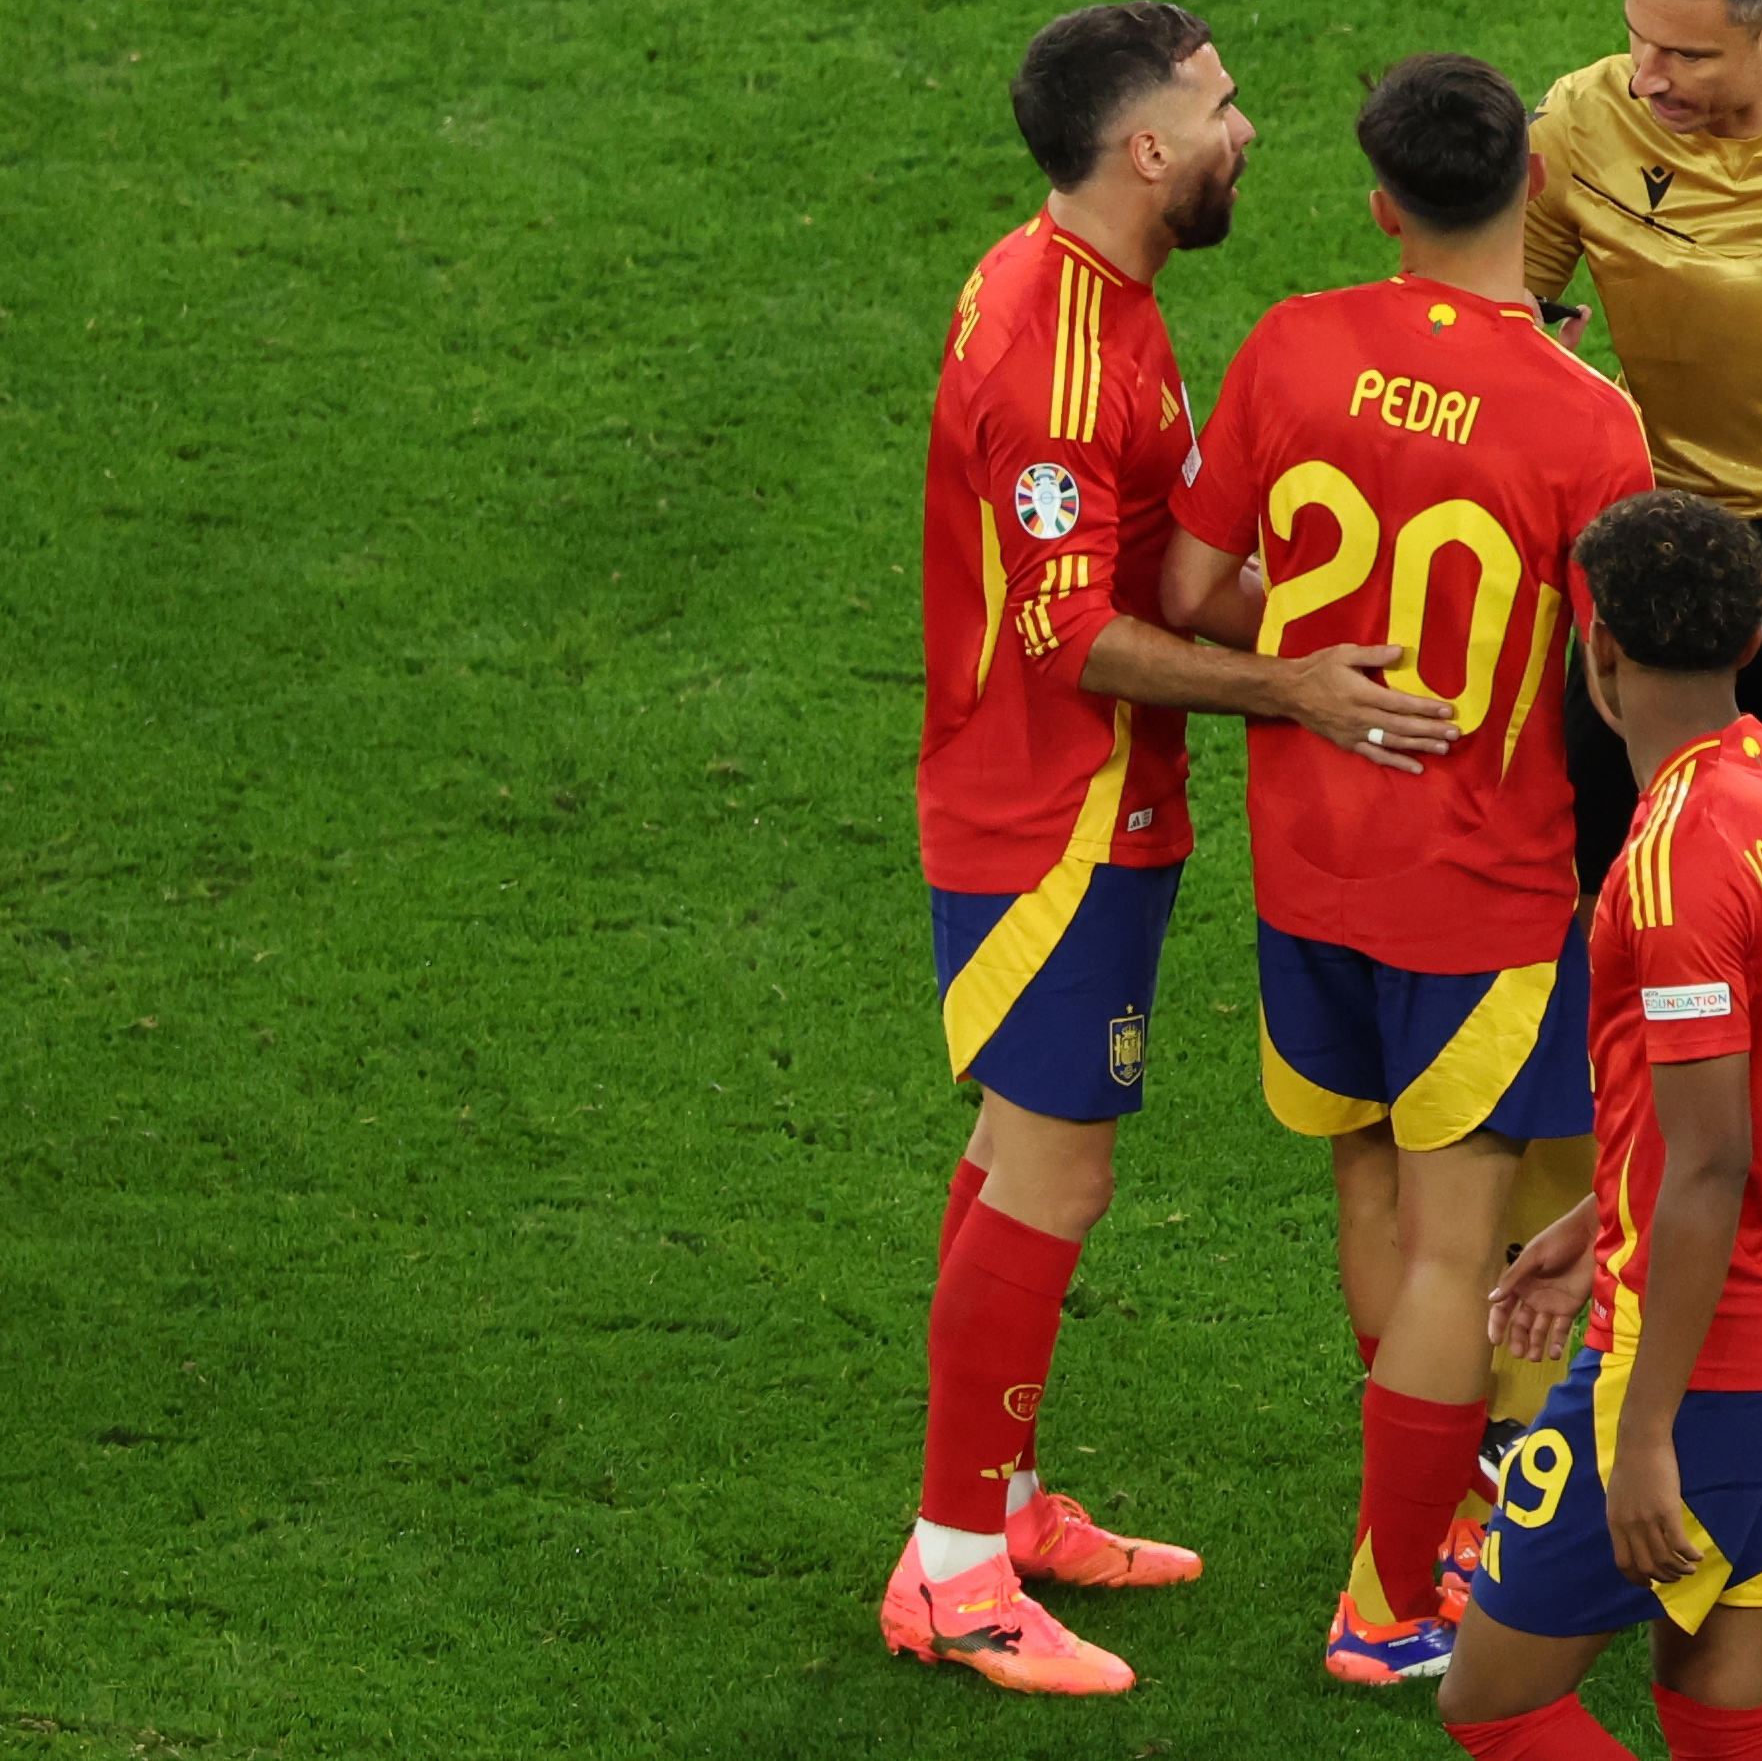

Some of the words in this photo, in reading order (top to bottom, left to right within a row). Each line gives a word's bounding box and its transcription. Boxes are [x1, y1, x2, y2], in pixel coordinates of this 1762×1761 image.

[1349, 369, 1481, 445] PEDRI
[1256, 460, 1522, 736] 20
[1644, 993, 1727, 1009] FOUNDATION
[1497, 1428, 1573, 1528] 19
